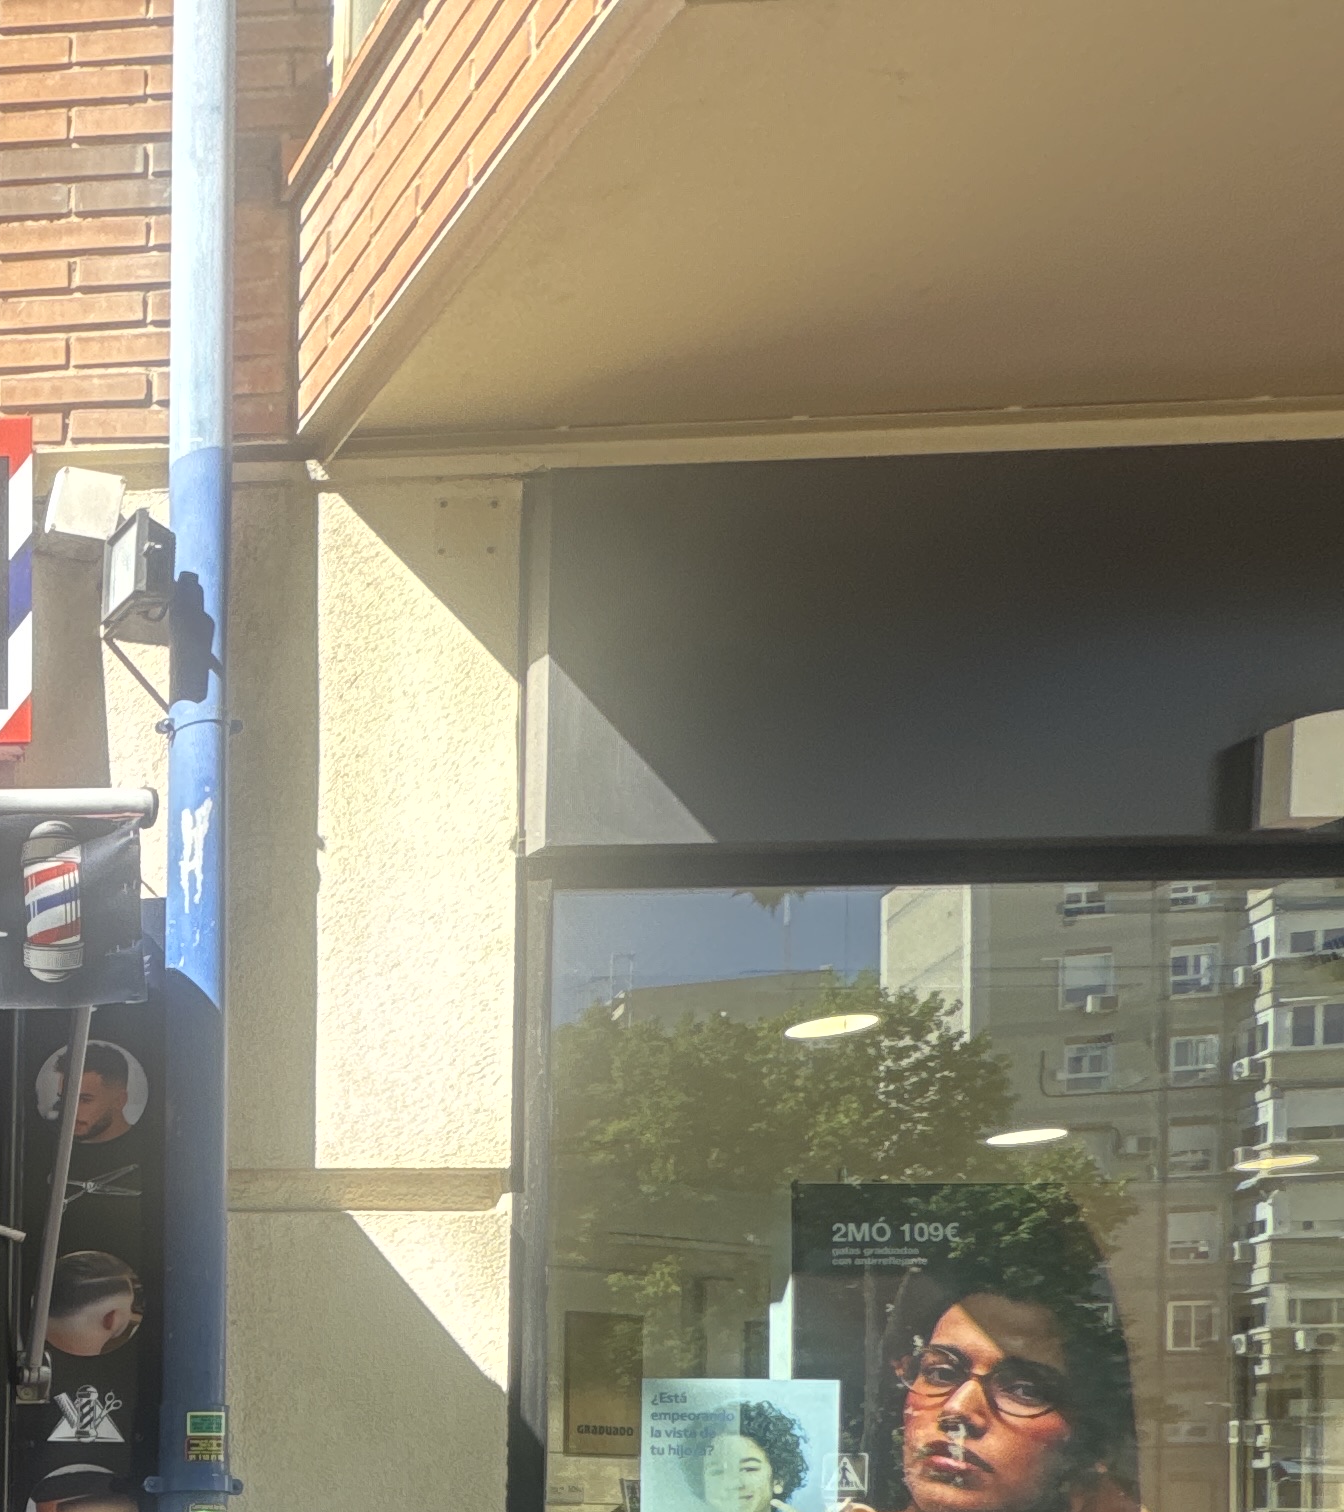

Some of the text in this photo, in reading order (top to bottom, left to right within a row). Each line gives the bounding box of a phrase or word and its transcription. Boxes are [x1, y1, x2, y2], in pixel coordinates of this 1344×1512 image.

[832, 1216, 960, 1242] 2MÓ 109€
[651, 1391, 687, 1405] ¿Está
[651, 1409, 734, 1424] empeorando
[577, 1424, 633, 1436] GRADUADO
[650, 1426, 661, 1438] la
[665, 1427, 697, 1438] vista
[650, 1444, 664, 1455] tu
